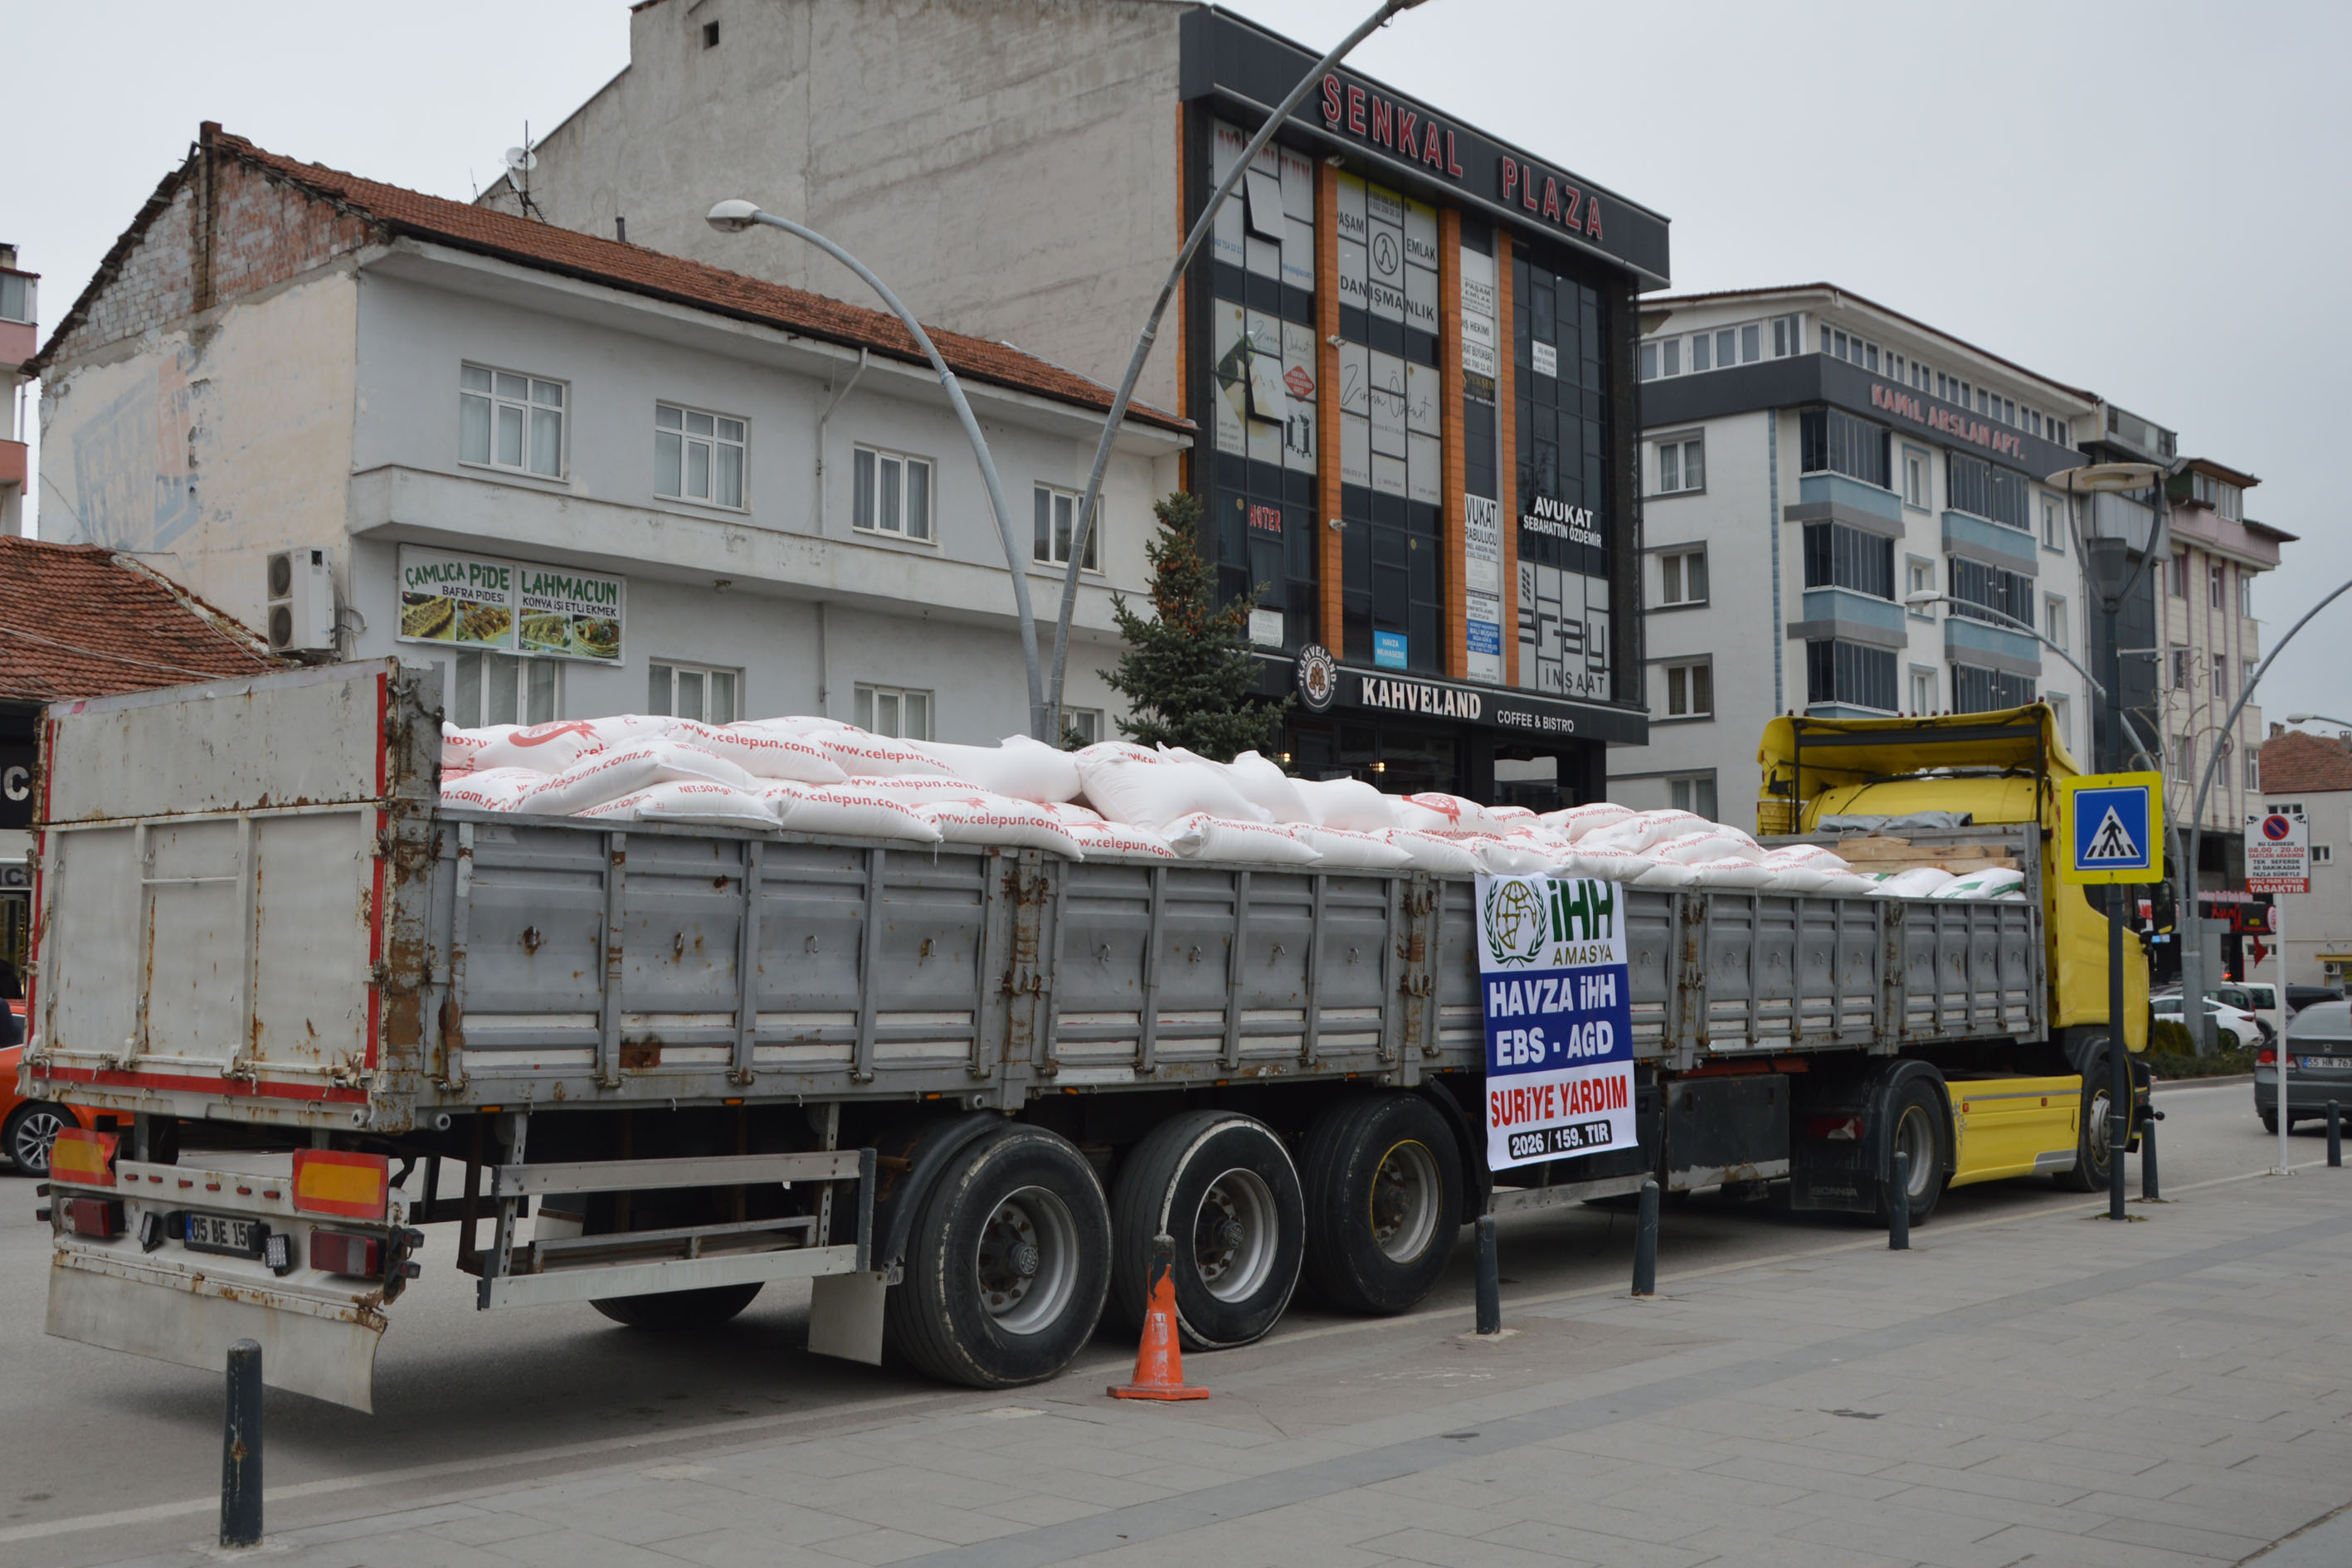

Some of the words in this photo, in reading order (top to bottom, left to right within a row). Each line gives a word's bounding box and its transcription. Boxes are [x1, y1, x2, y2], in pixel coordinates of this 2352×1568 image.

[1322, 73, 1463, 178] ŞENKAL
[1502, 155, 1604, 241] PLAZA
[1337, 211, 1365, 236] AŞAM
[1406, 238, 1436, 262] EMLAK
[1340, 275, 1434, 322] DANIŞMANLIK
[1464, 290, 1491, 304] EMLAK
[1871, 383, 1925, 423] KAMİL
[1927, 405, 1990, 448] ARSLAN
[1992, 430, 2026, 460] APT.
[1249, 504, 1282, 533] NOTER
[1465, 495, 1496, 530] VUKAT
[1534, 495, 1594, 530] AVUKAT
[1523, 514, 1568, 539] SEBAHATTİN
[1569, 522, 1602, 548] ÖZDEMİR
[405, 561, 466, 591] ÇAMLICA
[469, 562, 510, 592] PİDE
[521, 569, 617, 606] LAHMACUN
[442, 584, 474, 600] BAFRA
[475, 589, 504, 604] PİDESİ
[523, 595, 553, 610] KONYA
[565, 601, 584, 614] ETLİ
[586, 603, 616, 617] EKMEK
[1298, 645, 1337, 683] KAHVELAND
[1546, 662, 1605, 695] İNŞAAT
[1361, 676, 1482, 721] KAHVELAND
[1497, 709, 1533, 728] COFFEE
[1534, 714, 1541, 728] &
[1542, 716, 1575, 734] BISTRO
[2249, 884, 2305, 893] YASAKTIR
[1552, 943, 1614, 967] AMASYA
[1489, 976, 1575, 1019] HAVZA
[1496, 1026, 1546, 1068] EBS
[1566, 1020, 1614, 1059] AGD
[2307, 1057, 2320, 1067] 55
[2321, 1058, 2334, 1068] HN
[1490, 1083, 1555, 1129] SURİYE
[1559, 1074, 1628, 1118] YARDIM
[1512, 1132, 1545, 1157] 2026
[1547, 1130, 1553, 1153] /
[1555, 1126, 1584, 1150] 159.
[1585, 1122, 1610, 1144] TIR
[1811, 1186, 1859, 1197] SCANIA
[192, 1217, 208, 1242] 05
[211, 1219, 228, 1244] BE
[232, 1221, 249, 1247] 15
